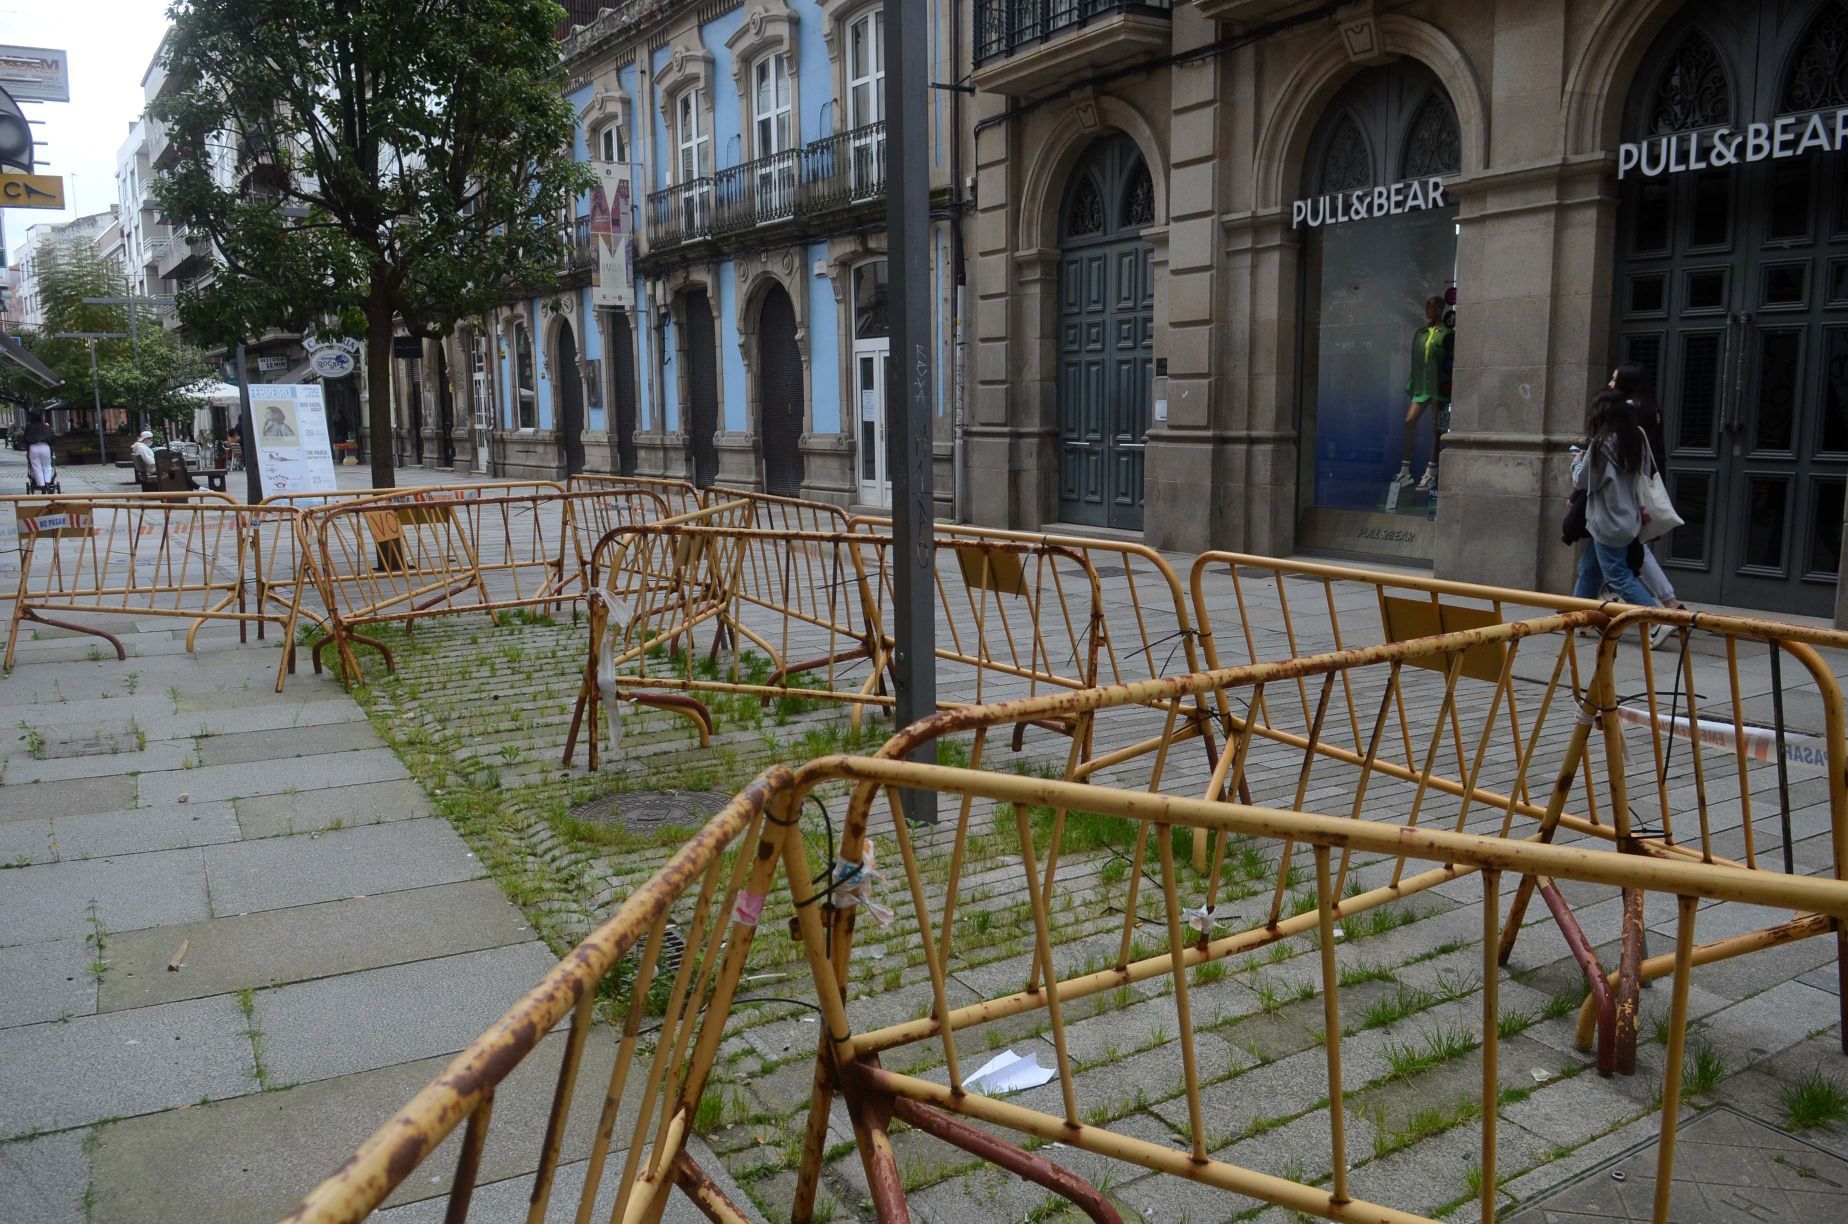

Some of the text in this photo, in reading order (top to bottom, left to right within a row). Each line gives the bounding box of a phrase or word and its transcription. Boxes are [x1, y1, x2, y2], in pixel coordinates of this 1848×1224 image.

[1292, 176, 1445, 230] PULL&BEAR
[39, 517, 66, 529] NO PASAR
